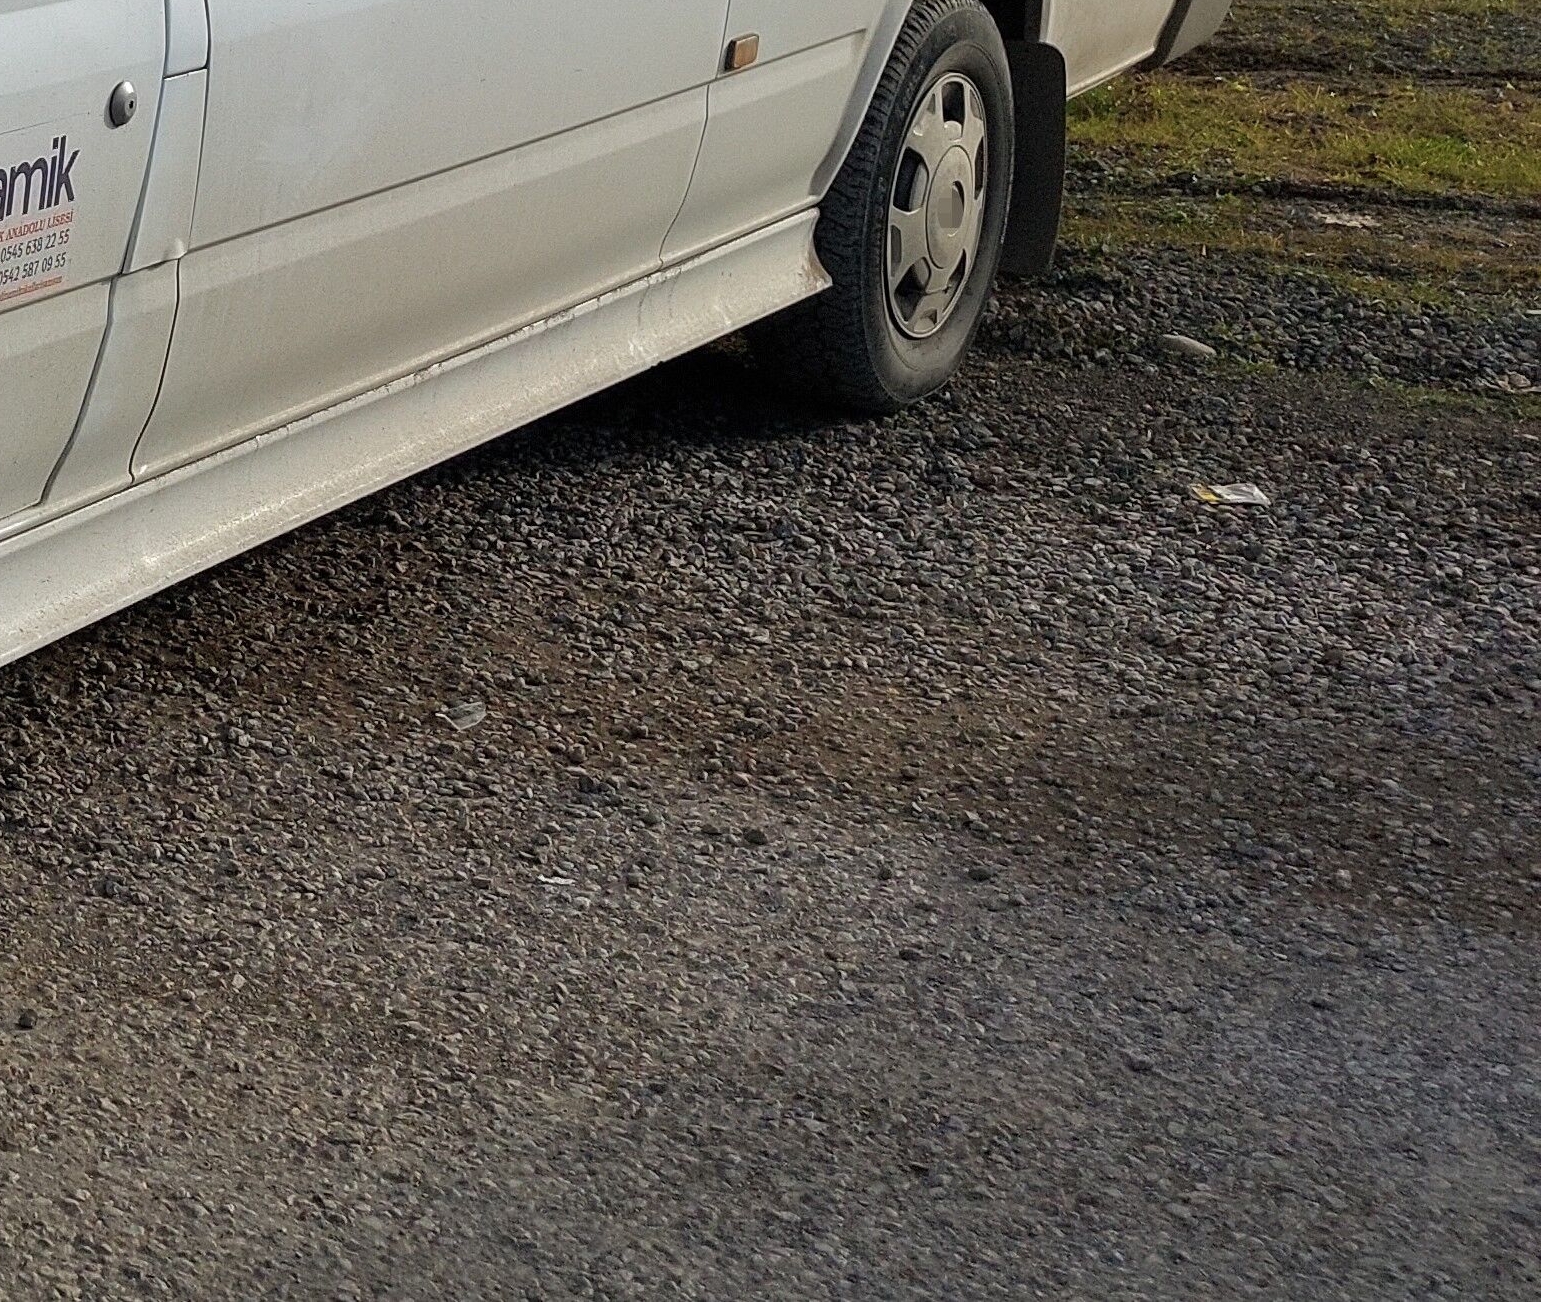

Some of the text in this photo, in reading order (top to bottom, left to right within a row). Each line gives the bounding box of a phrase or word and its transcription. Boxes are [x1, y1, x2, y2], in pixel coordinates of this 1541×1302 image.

[44, 233, 57, 250] 22
[58, 228, 70, 245] 55
[21, 260, 40, 278] 587
[40, 255, 54, 272] 09
[54, 251, 67, 268] 55
